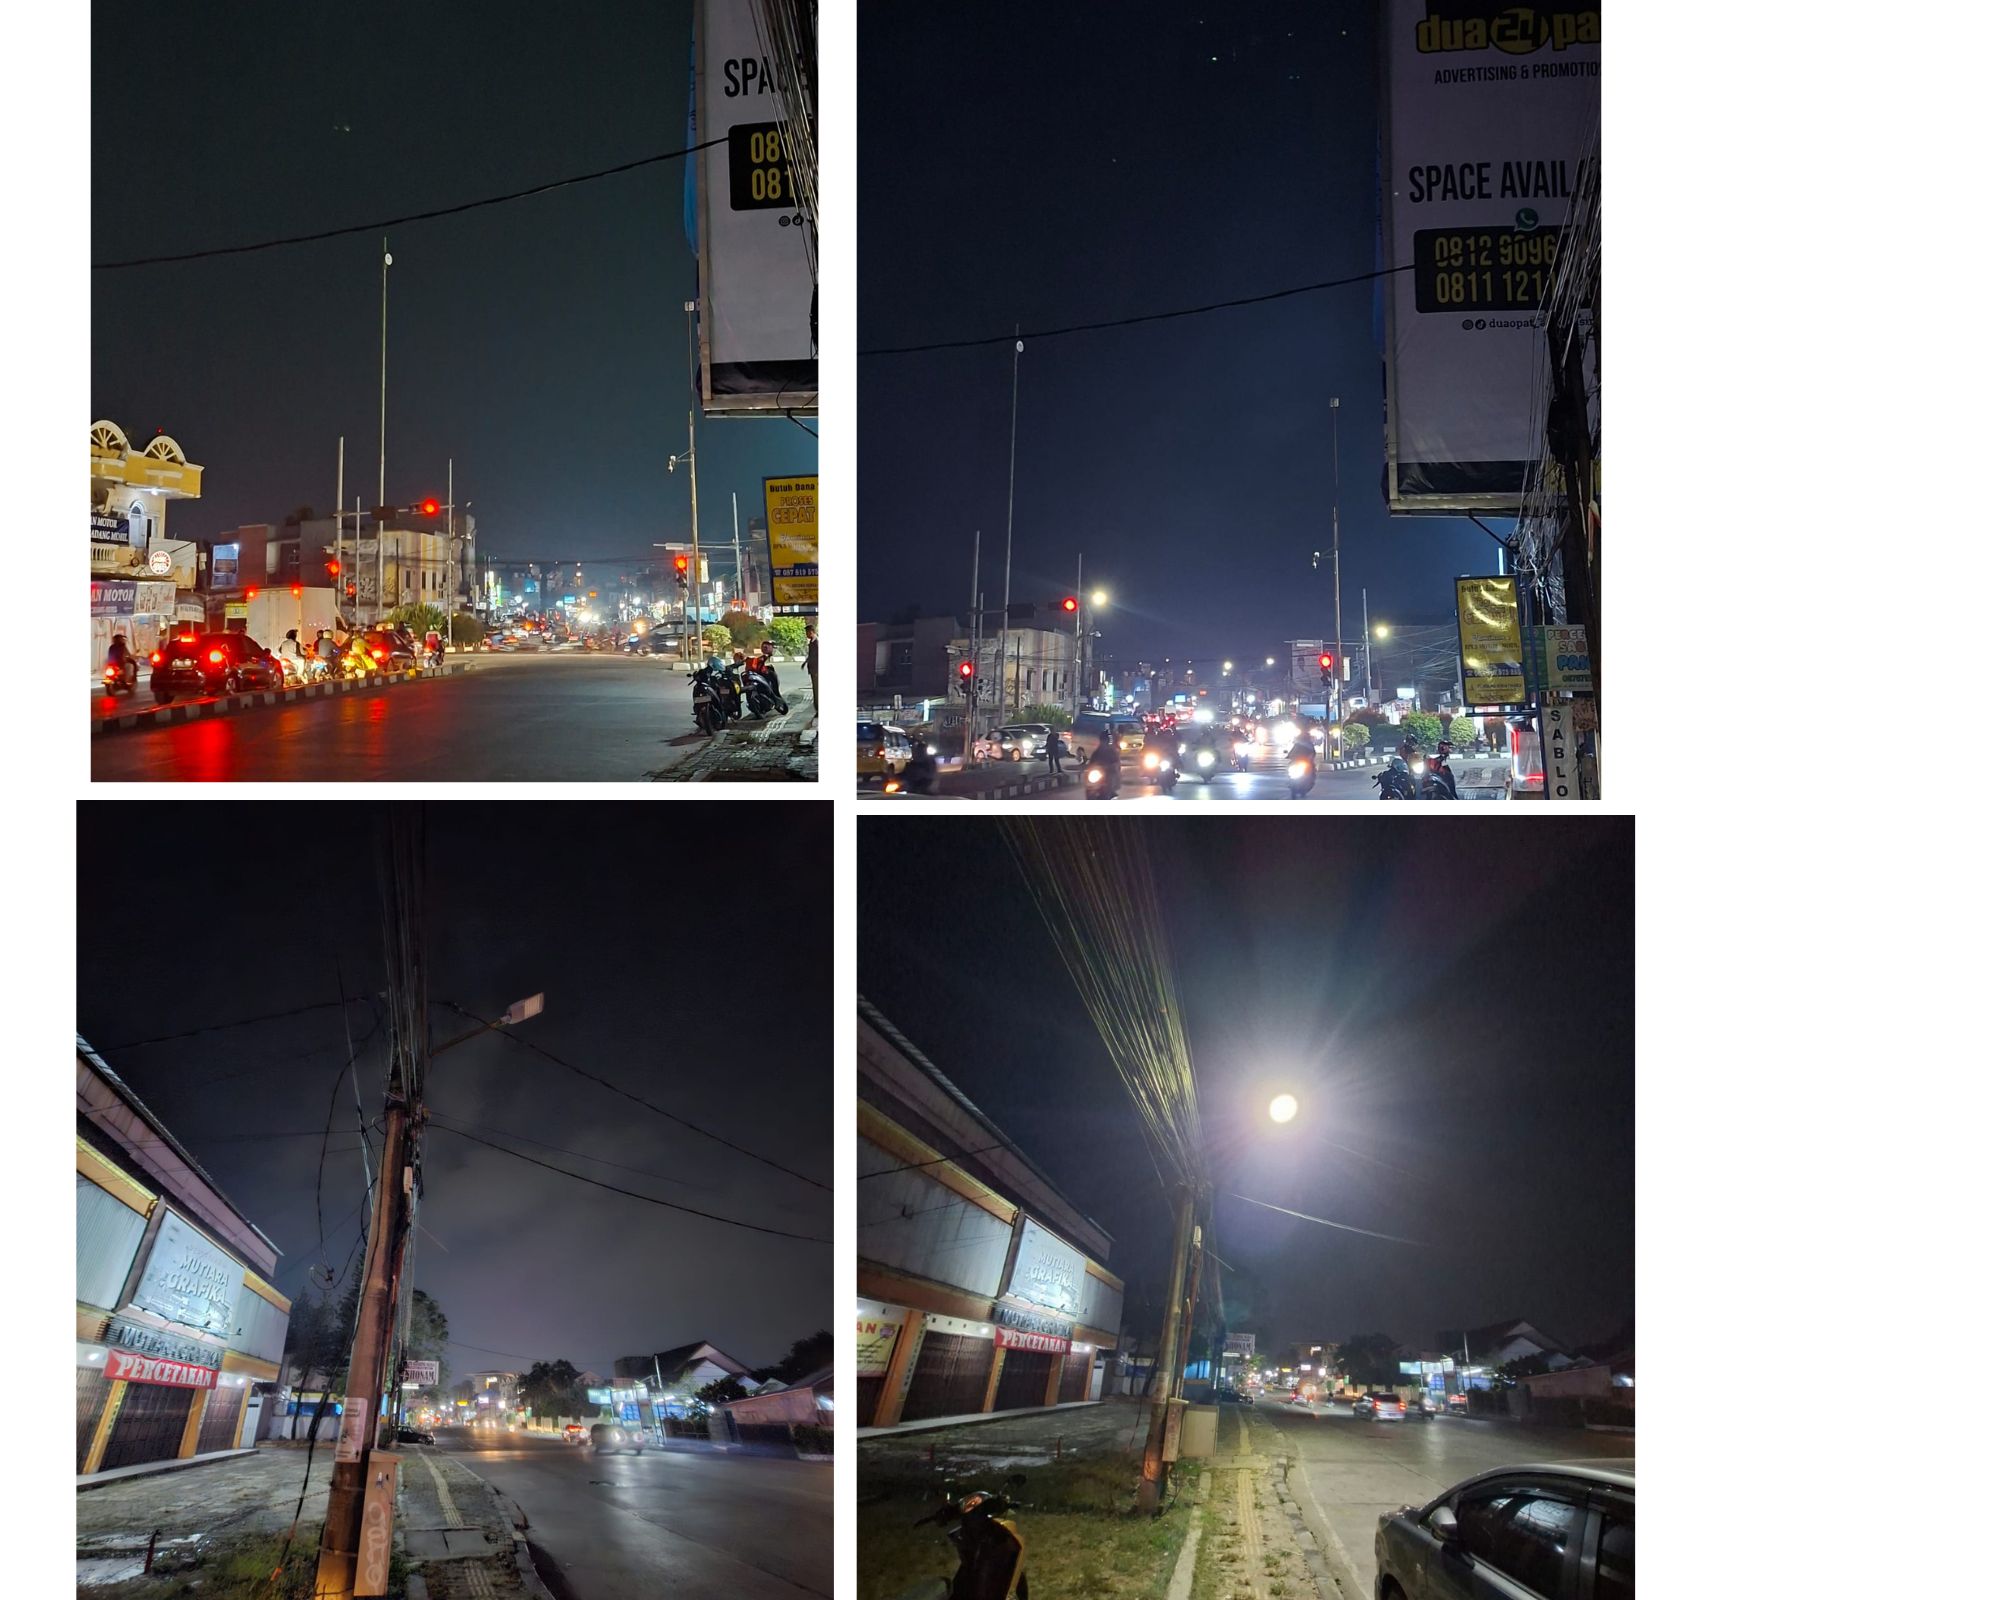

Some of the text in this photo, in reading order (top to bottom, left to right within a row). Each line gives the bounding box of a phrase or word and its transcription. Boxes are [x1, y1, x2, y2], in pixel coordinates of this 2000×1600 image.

[1416, 13, 1488, 53] dua
[1434, 61, 1600, 85] ADVERTISING & PROMOTIO
[1408, 162, 1491, 203] SPACE
[1434, 233, 1558, 268] 0812 9096
[1435, 270, 1493, 304] 0811
[771, 506, 816, 524] CEPAT
[103, 588, 135, 602] MOTOR
[180, 1254, 230, 1288] MUTIARA
[166, 1272, 228, 1306] GRAFIKA
[1002, 1329, 1067, 1354] PERCETAKAN
[115, 1354, 213, 1387] PERCETAKAN
